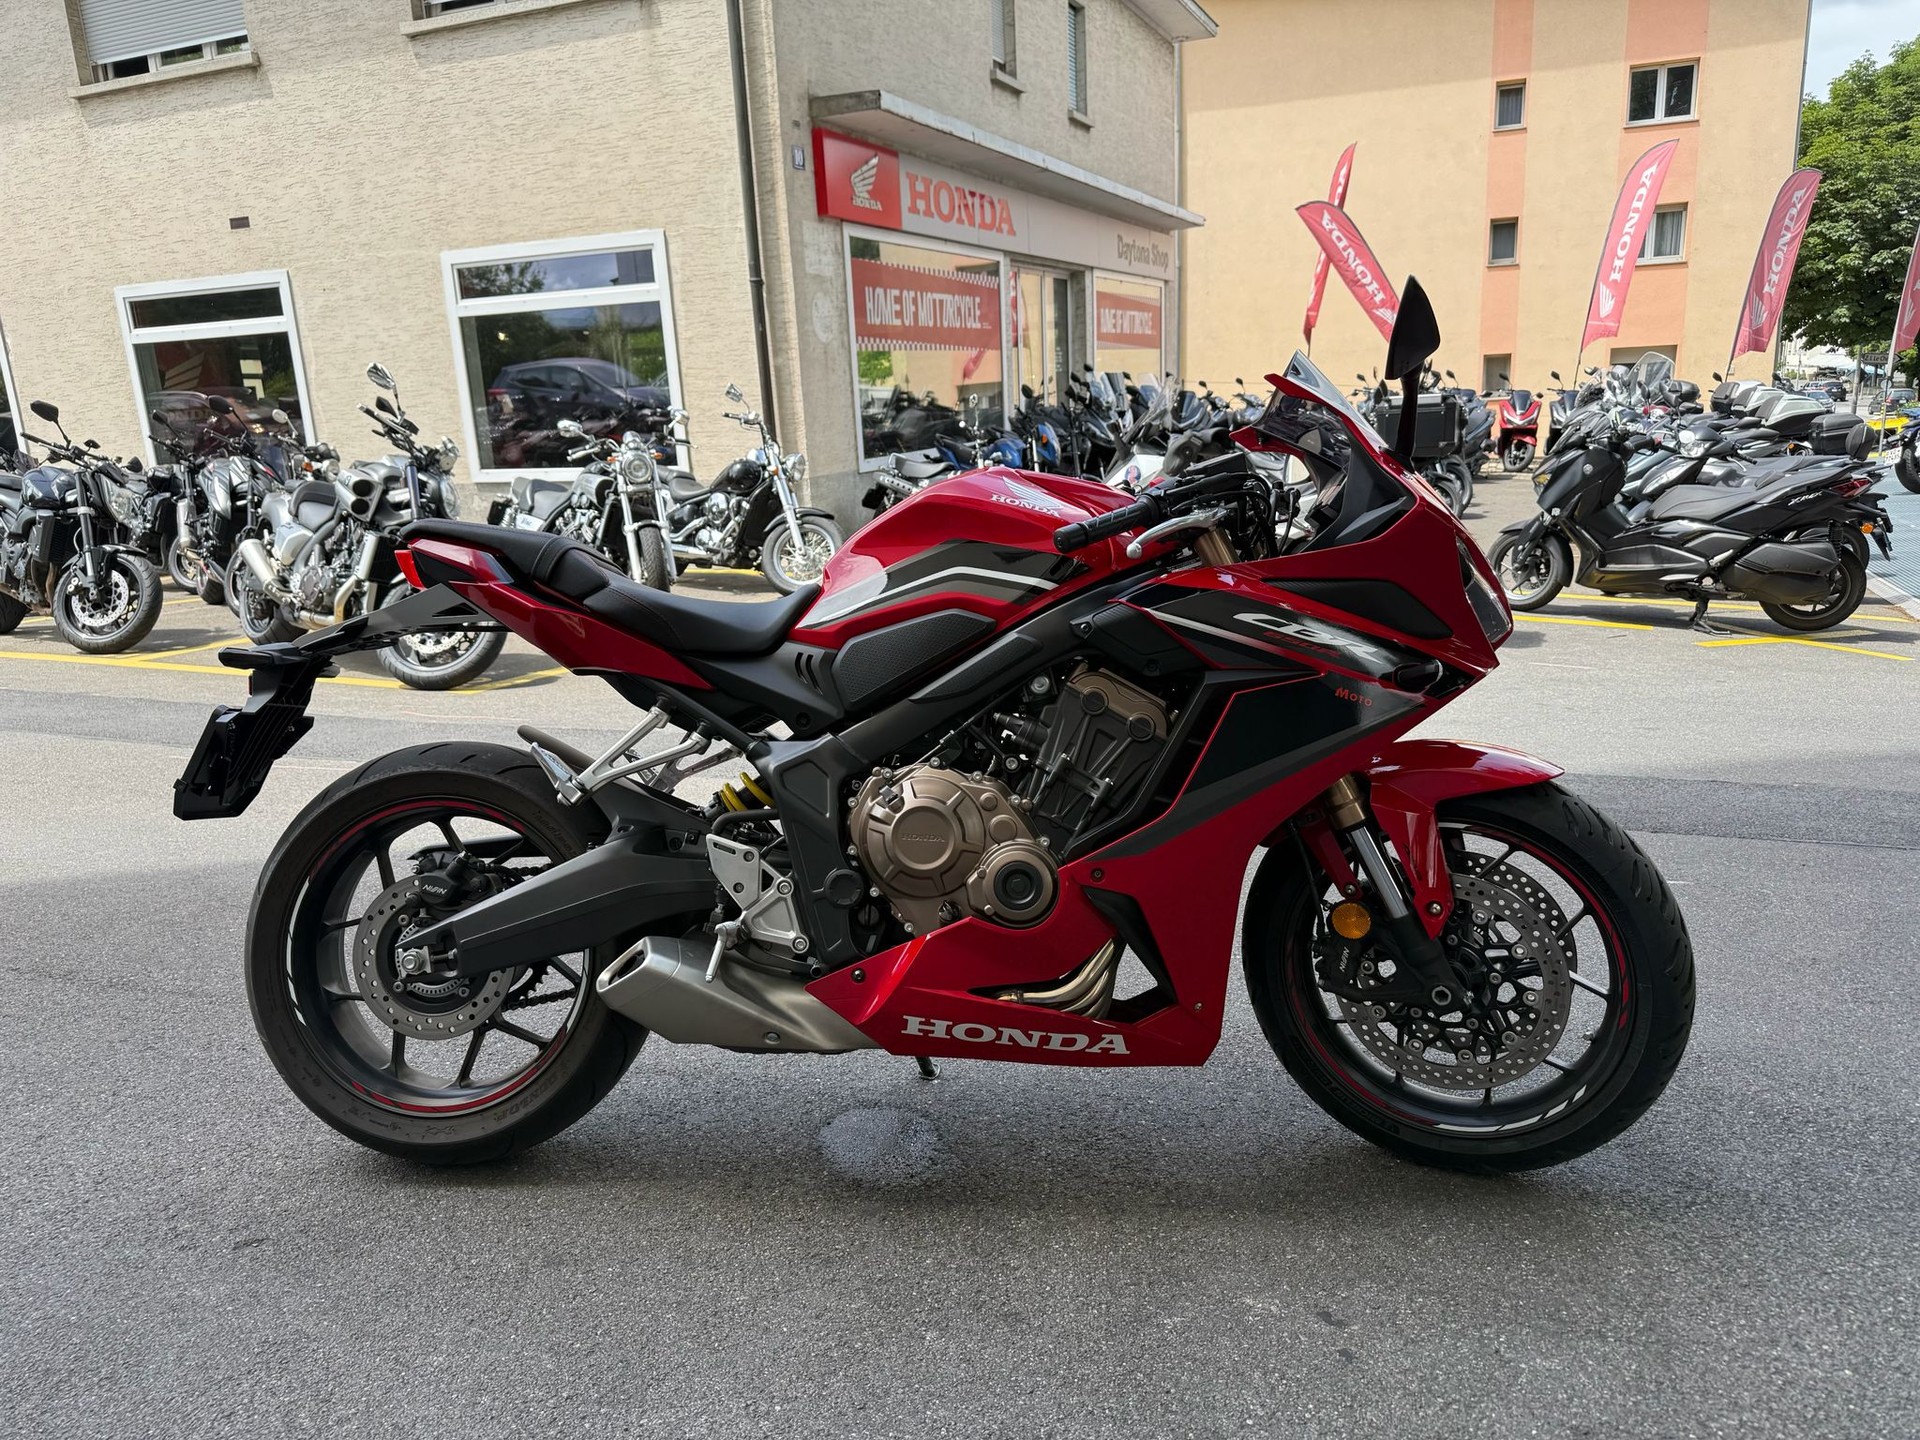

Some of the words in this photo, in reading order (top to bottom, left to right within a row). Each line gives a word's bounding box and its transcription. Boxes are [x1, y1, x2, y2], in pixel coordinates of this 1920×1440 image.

[852, 195, 883, 211] HONDA
[905, 171, 1017, 237] HONDA
[1609, 161, 1659, 283] HONDA
[1117, 234, 1150, 266] Daytona
[1151, 242, 1169, 272] Shop
[1321, 208, 1386, 305] HONDA
[1763, 187, 1807, 295] HONDA
[902, 289, 916, 327] OF
[991, 494, 1060, 517] HONDA
[1233, 613, 1384, 664] CBR
[901, 1015, 1130, 1055] HONDA
